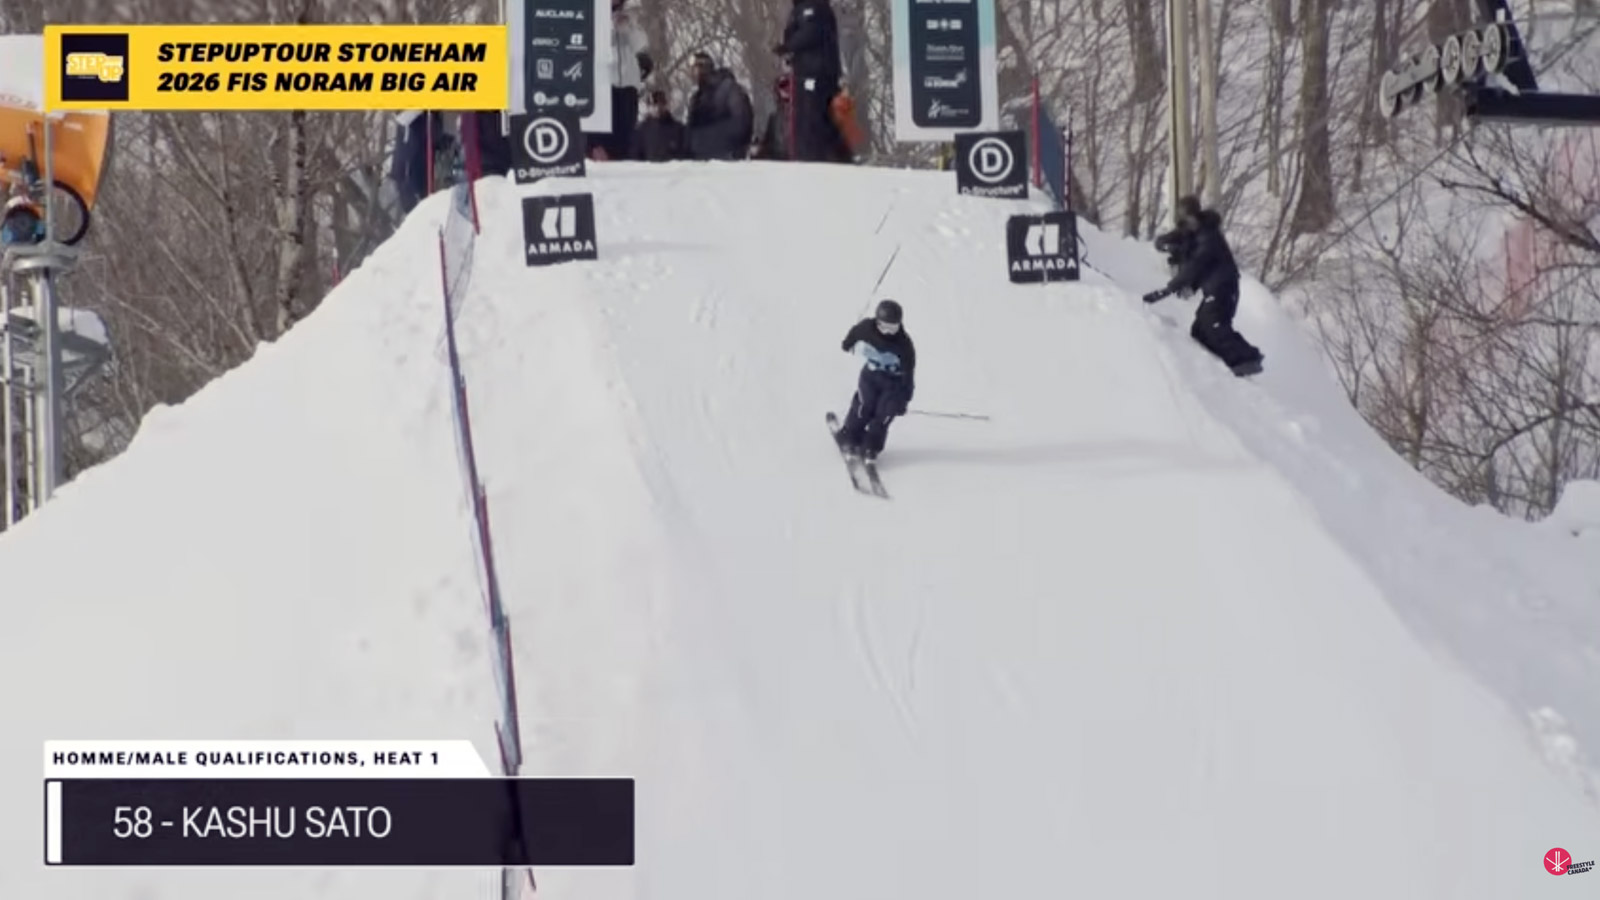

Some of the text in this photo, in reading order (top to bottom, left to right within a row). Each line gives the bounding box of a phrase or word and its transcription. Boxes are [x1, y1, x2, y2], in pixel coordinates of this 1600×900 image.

[535, 9, 575, 18] AUCLAIR
[535, 126, 559, 154] D
[980, 146, 1004, 174] D
[528, 240, 594, 255] ARMADA
[1011, 257, 1077, 272] ARMADA
